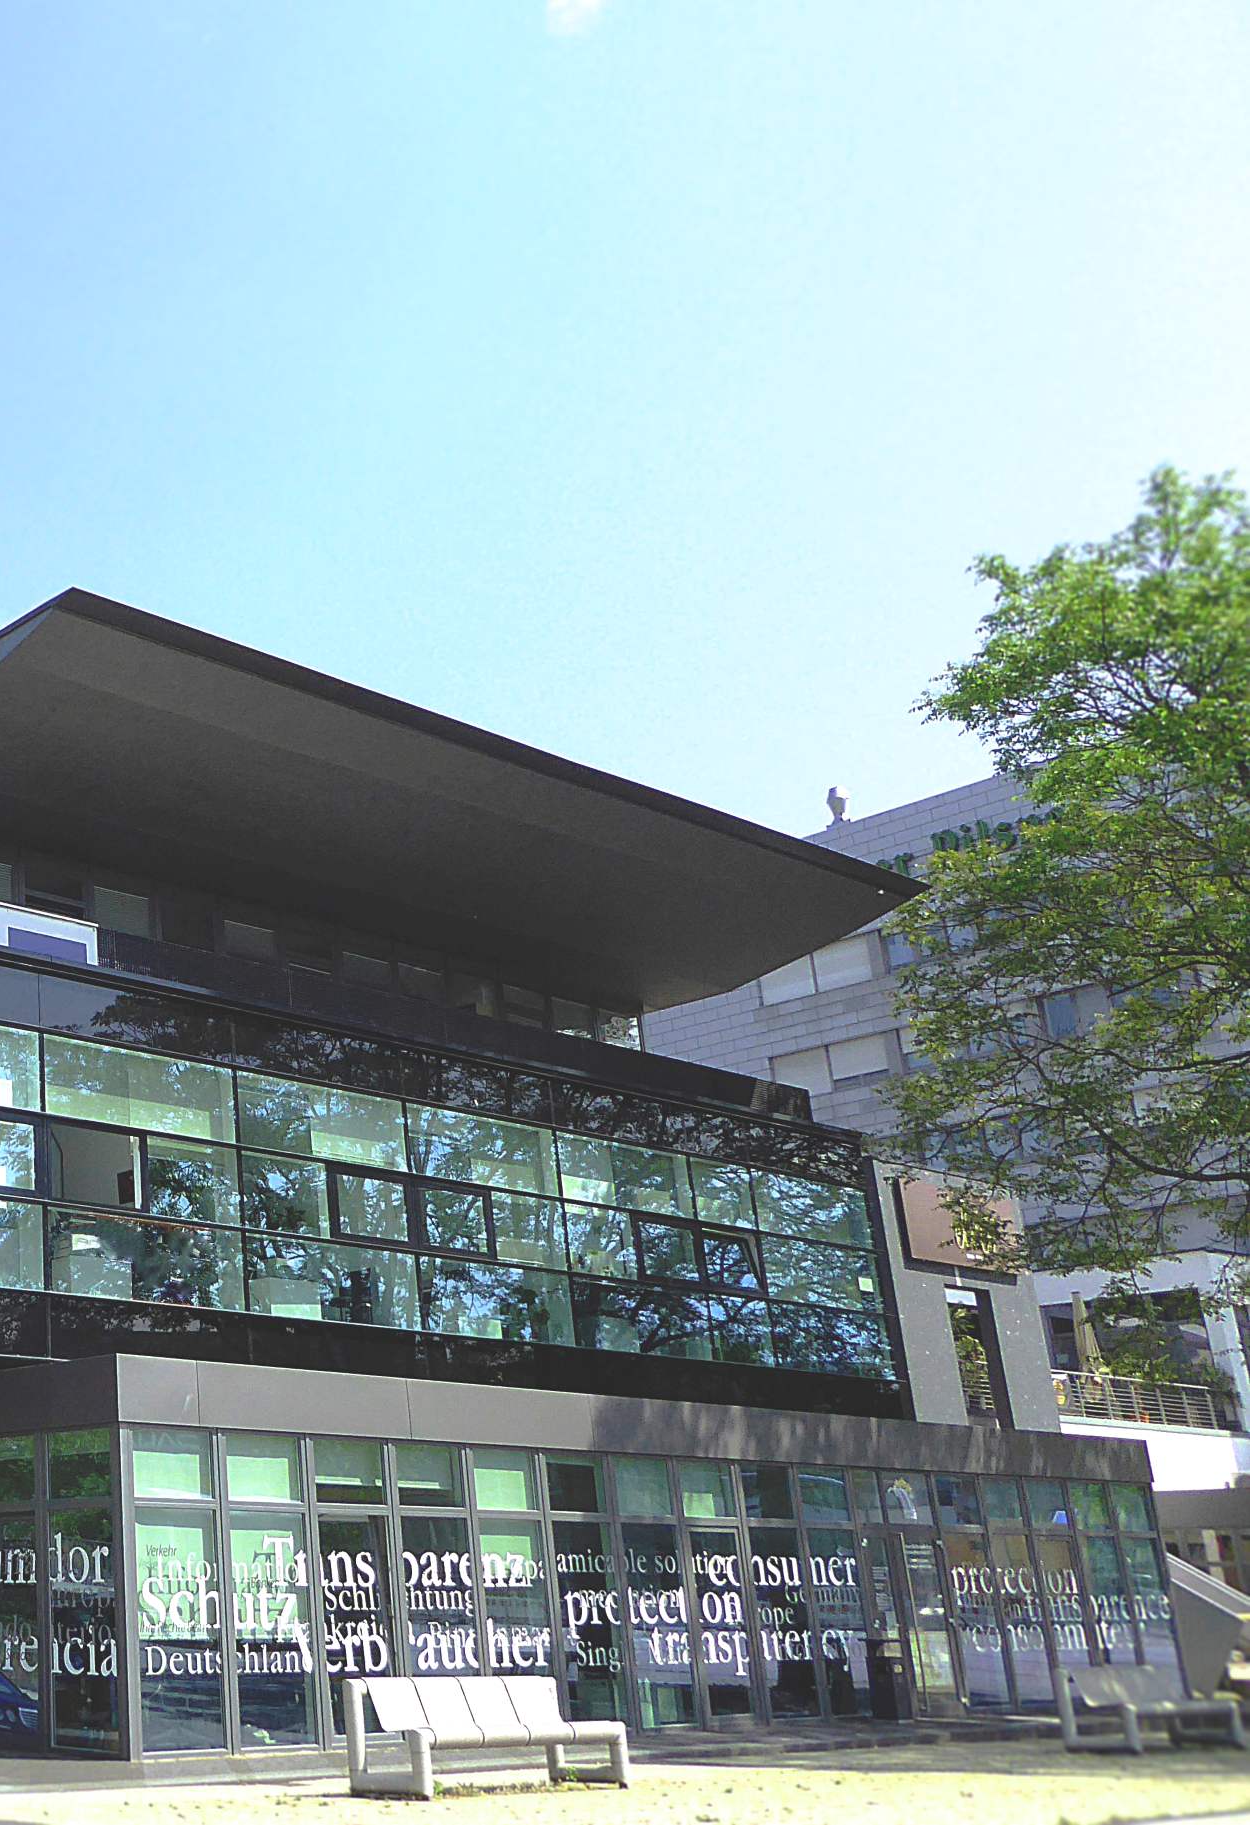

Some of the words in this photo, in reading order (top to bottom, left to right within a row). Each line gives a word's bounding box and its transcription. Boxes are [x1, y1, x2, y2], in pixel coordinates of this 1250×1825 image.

[146, 1544, 177, 1557] Verkehr
[141, 1574, 298, 1632] Schutz
[324, 1583, 474, 1616] Schlihtung
[951, 1561, 1078, 1606] proecion
[564, 1586, 743, 1639] protecton
[294, 1615, 550, 1674] Verbaucher
